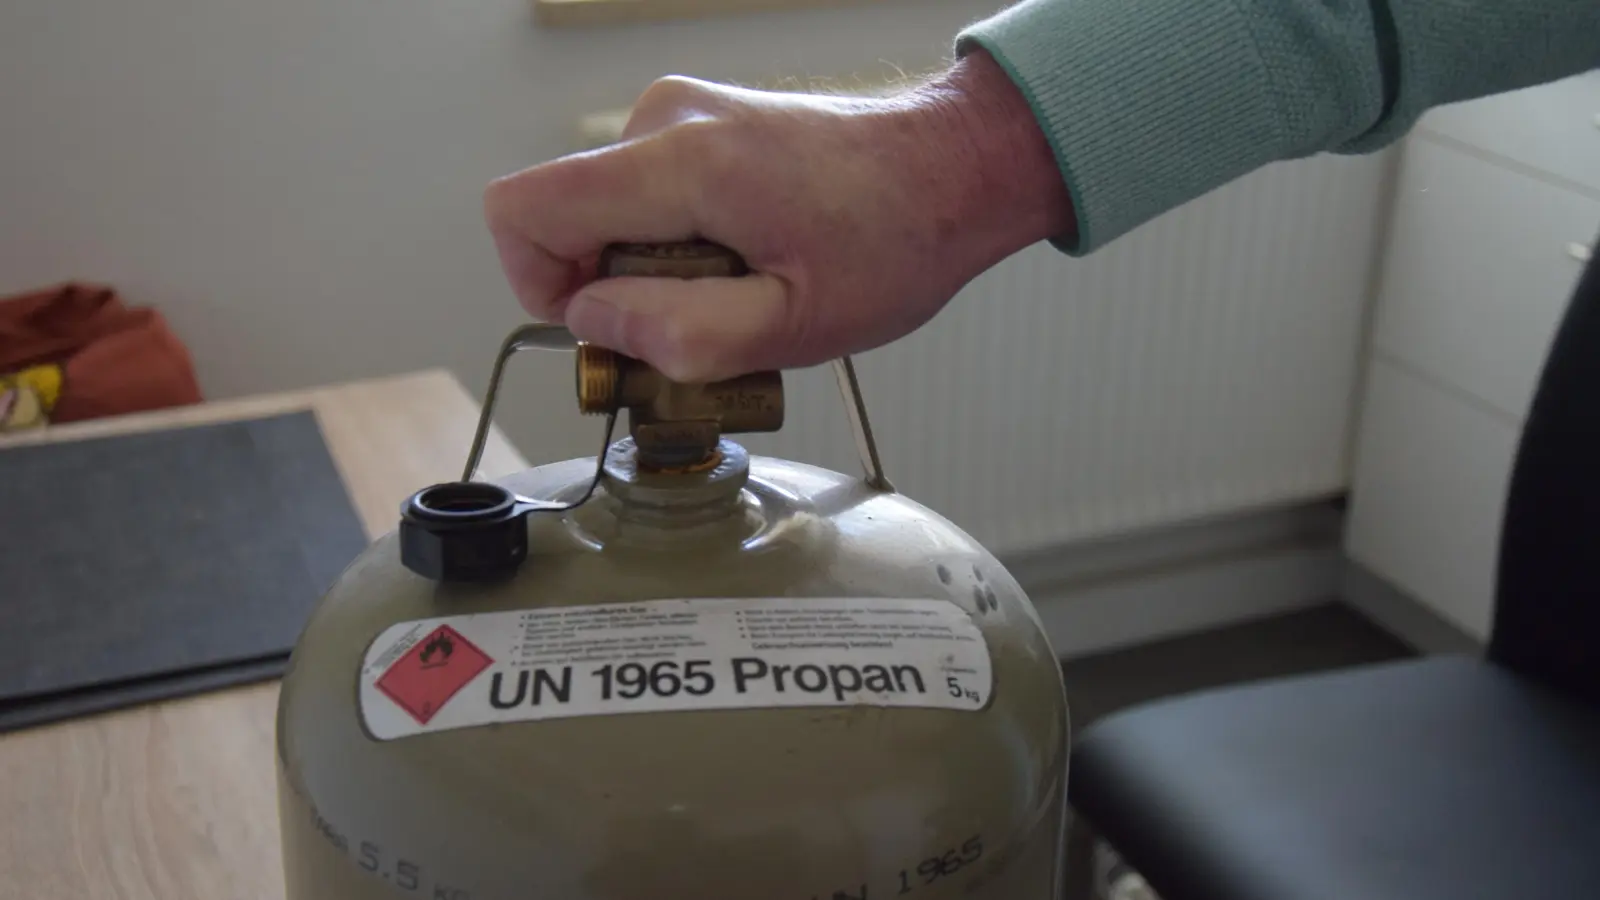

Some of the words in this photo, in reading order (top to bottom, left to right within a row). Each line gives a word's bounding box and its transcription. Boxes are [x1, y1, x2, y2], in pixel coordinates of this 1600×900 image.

[490, 666, 571, 709] UN
[592, 660, 714, 699] 1965
[731, 658, 926, 700] Propan
[947, 677, 962, 698] 5
[898, 835, 983, 895] 1965
